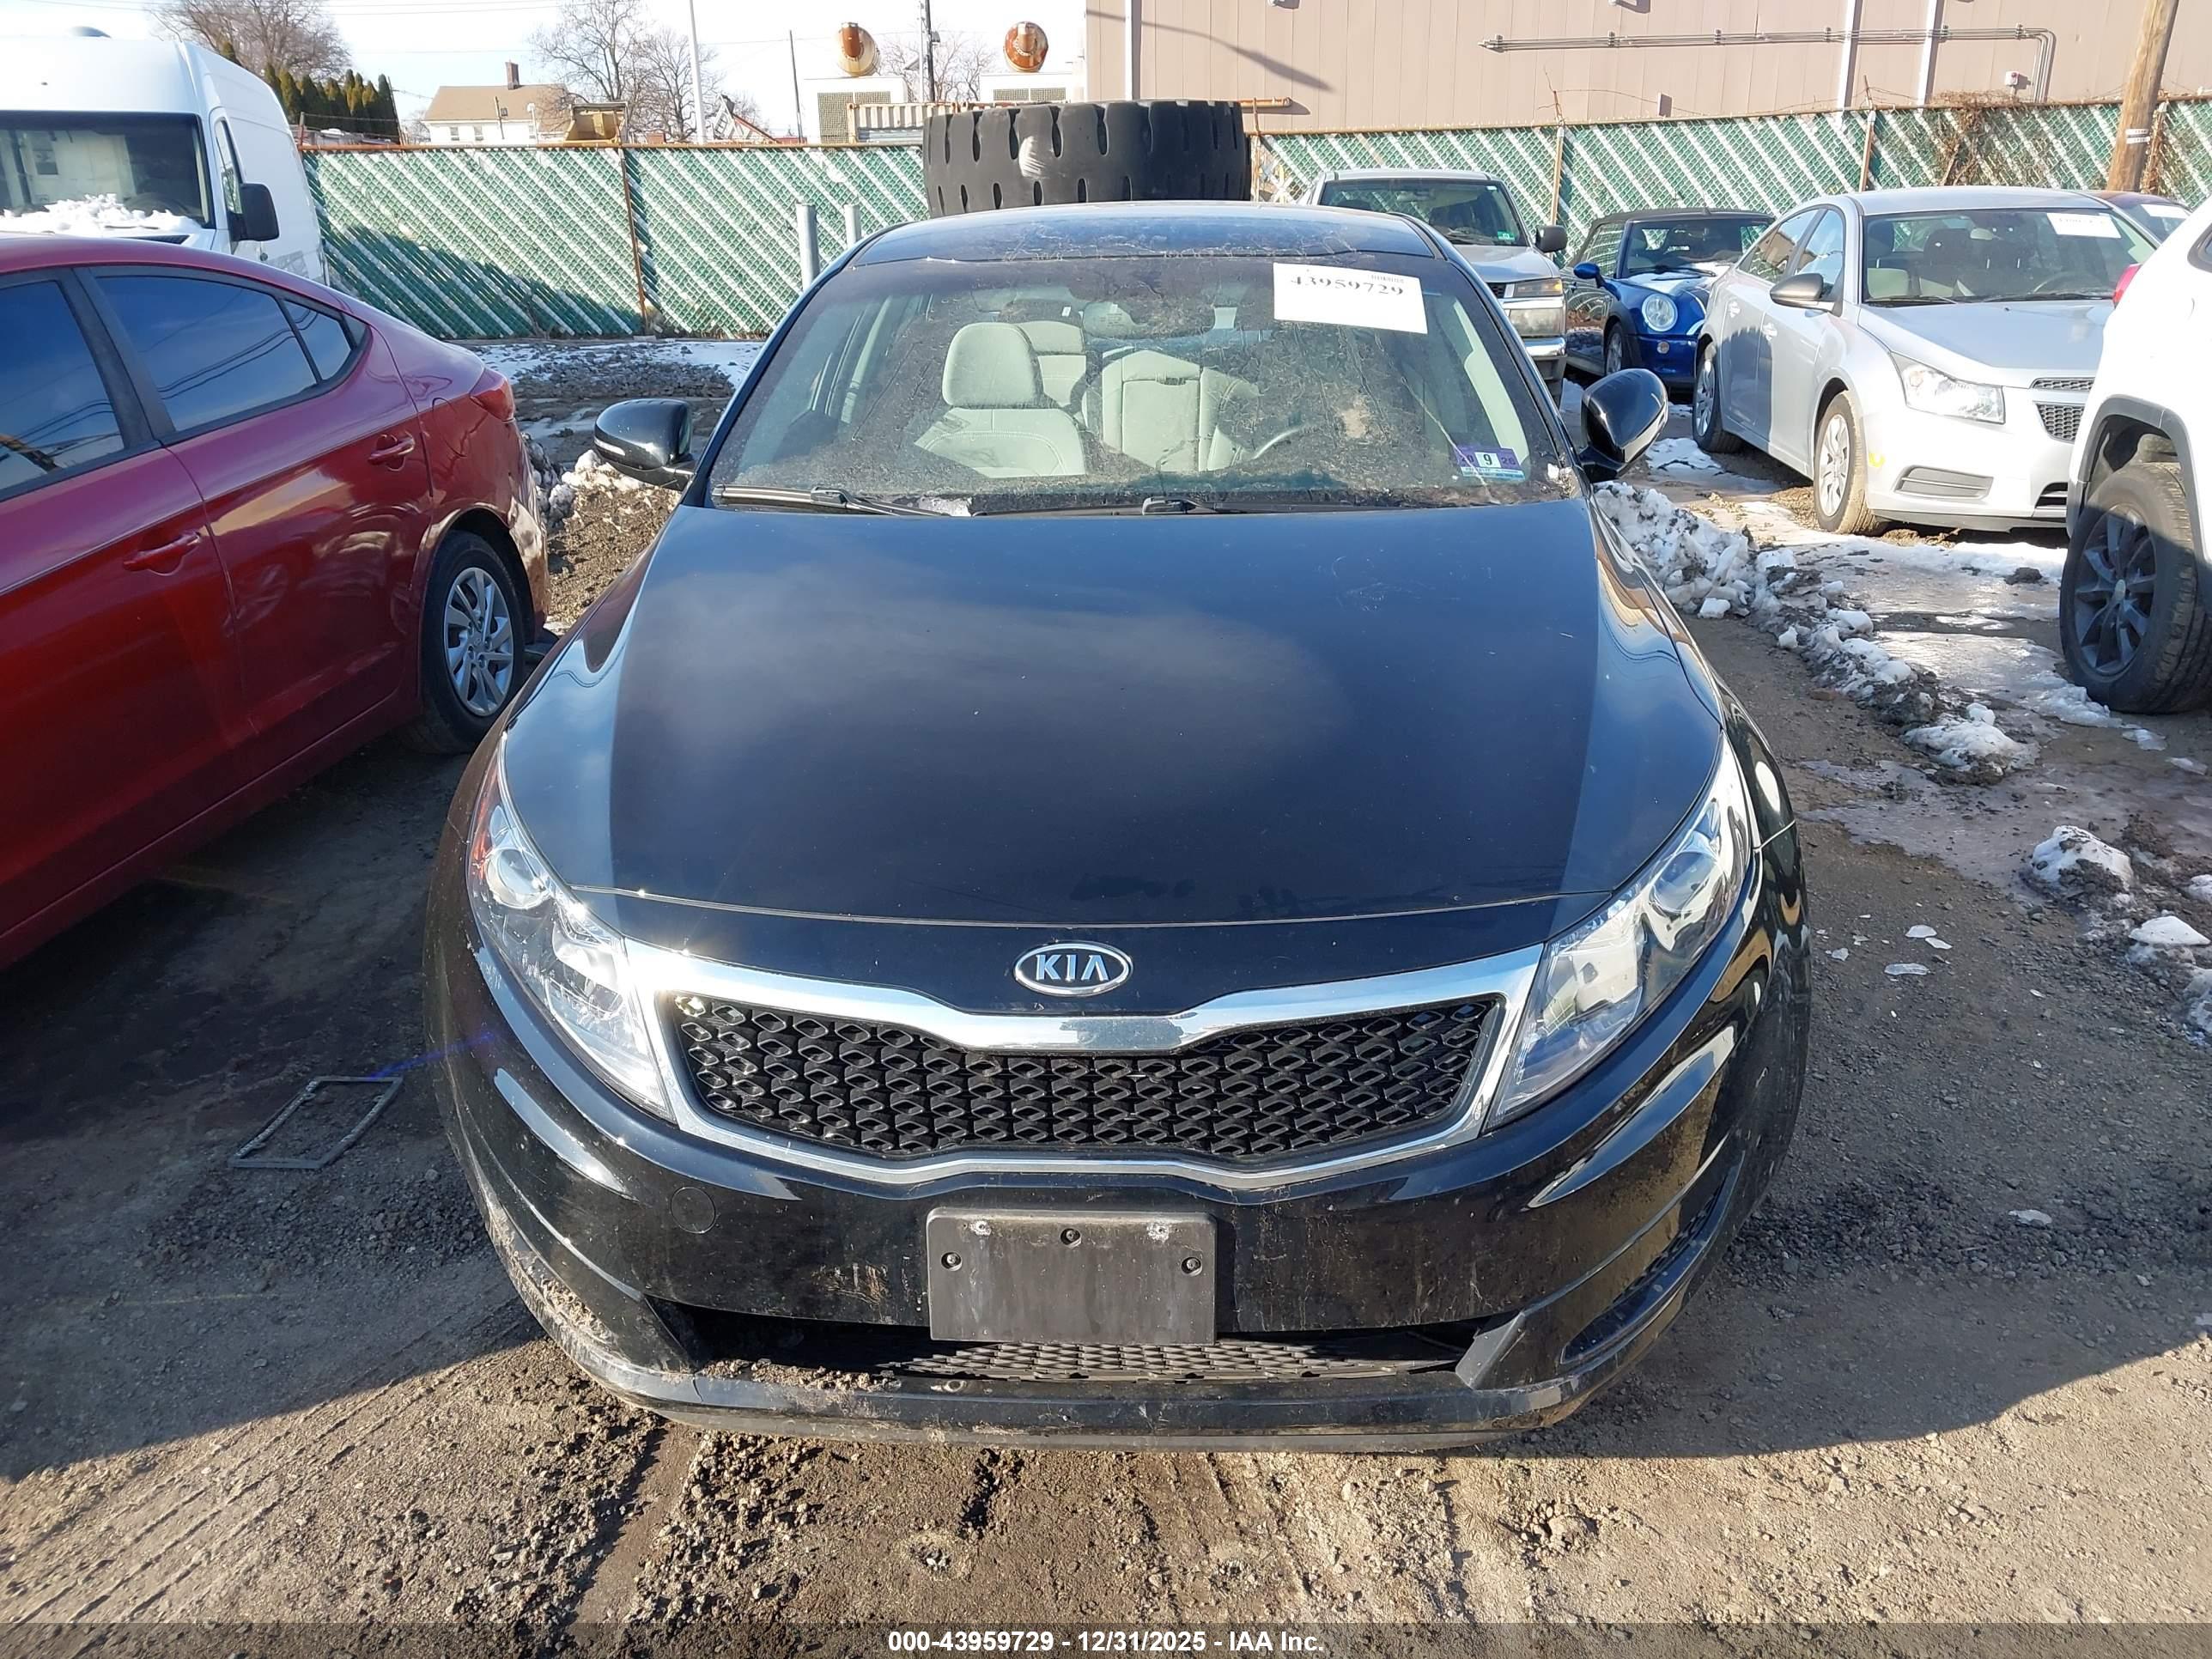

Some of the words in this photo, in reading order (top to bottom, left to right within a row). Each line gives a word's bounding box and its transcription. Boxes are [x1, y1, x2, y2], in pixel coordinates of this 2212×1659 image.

[1291, 276, 1404, 295] 43959729
[1483, 453, 1492, 465] 9
[1036, 954, 1109, 981] KIA
